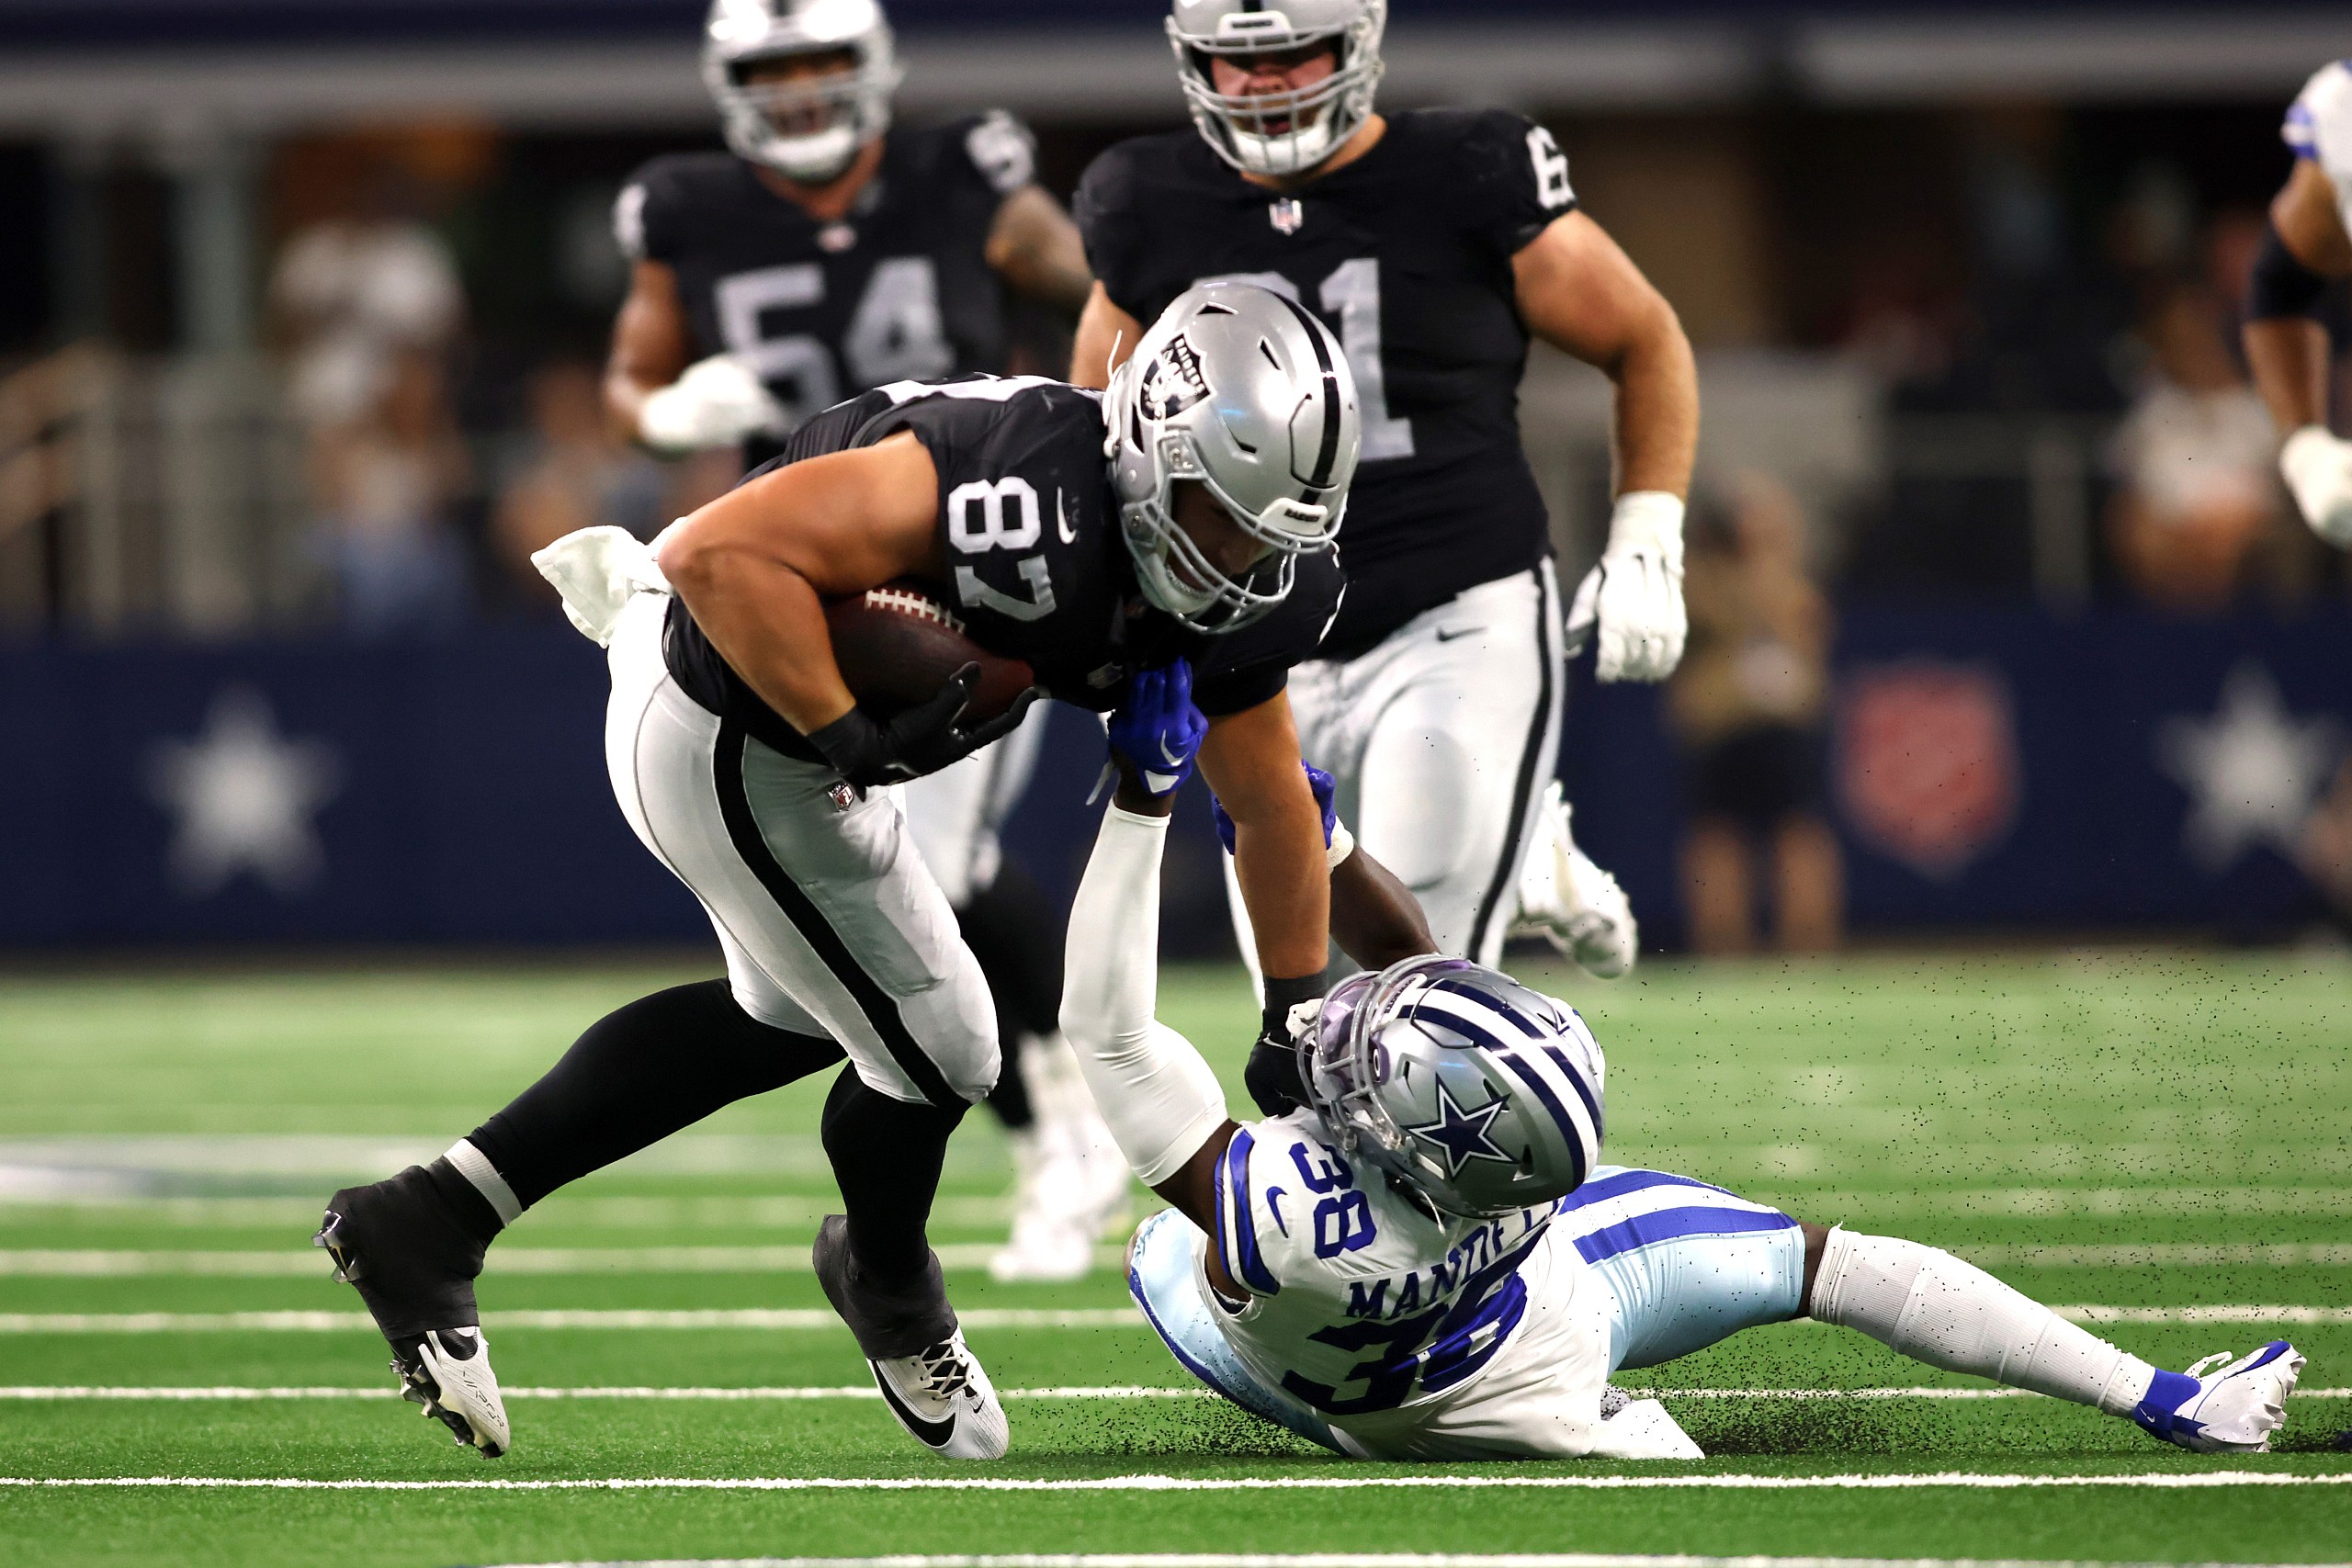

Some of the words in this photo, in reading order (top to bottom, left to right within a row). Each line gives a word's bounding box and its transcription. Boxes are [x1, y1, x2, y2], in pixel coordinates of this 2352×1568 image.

[713, 255, 957, 418] 54
[947, 476, 1057, 622] 87
[1288, 1142, 1378, 1260] 38
